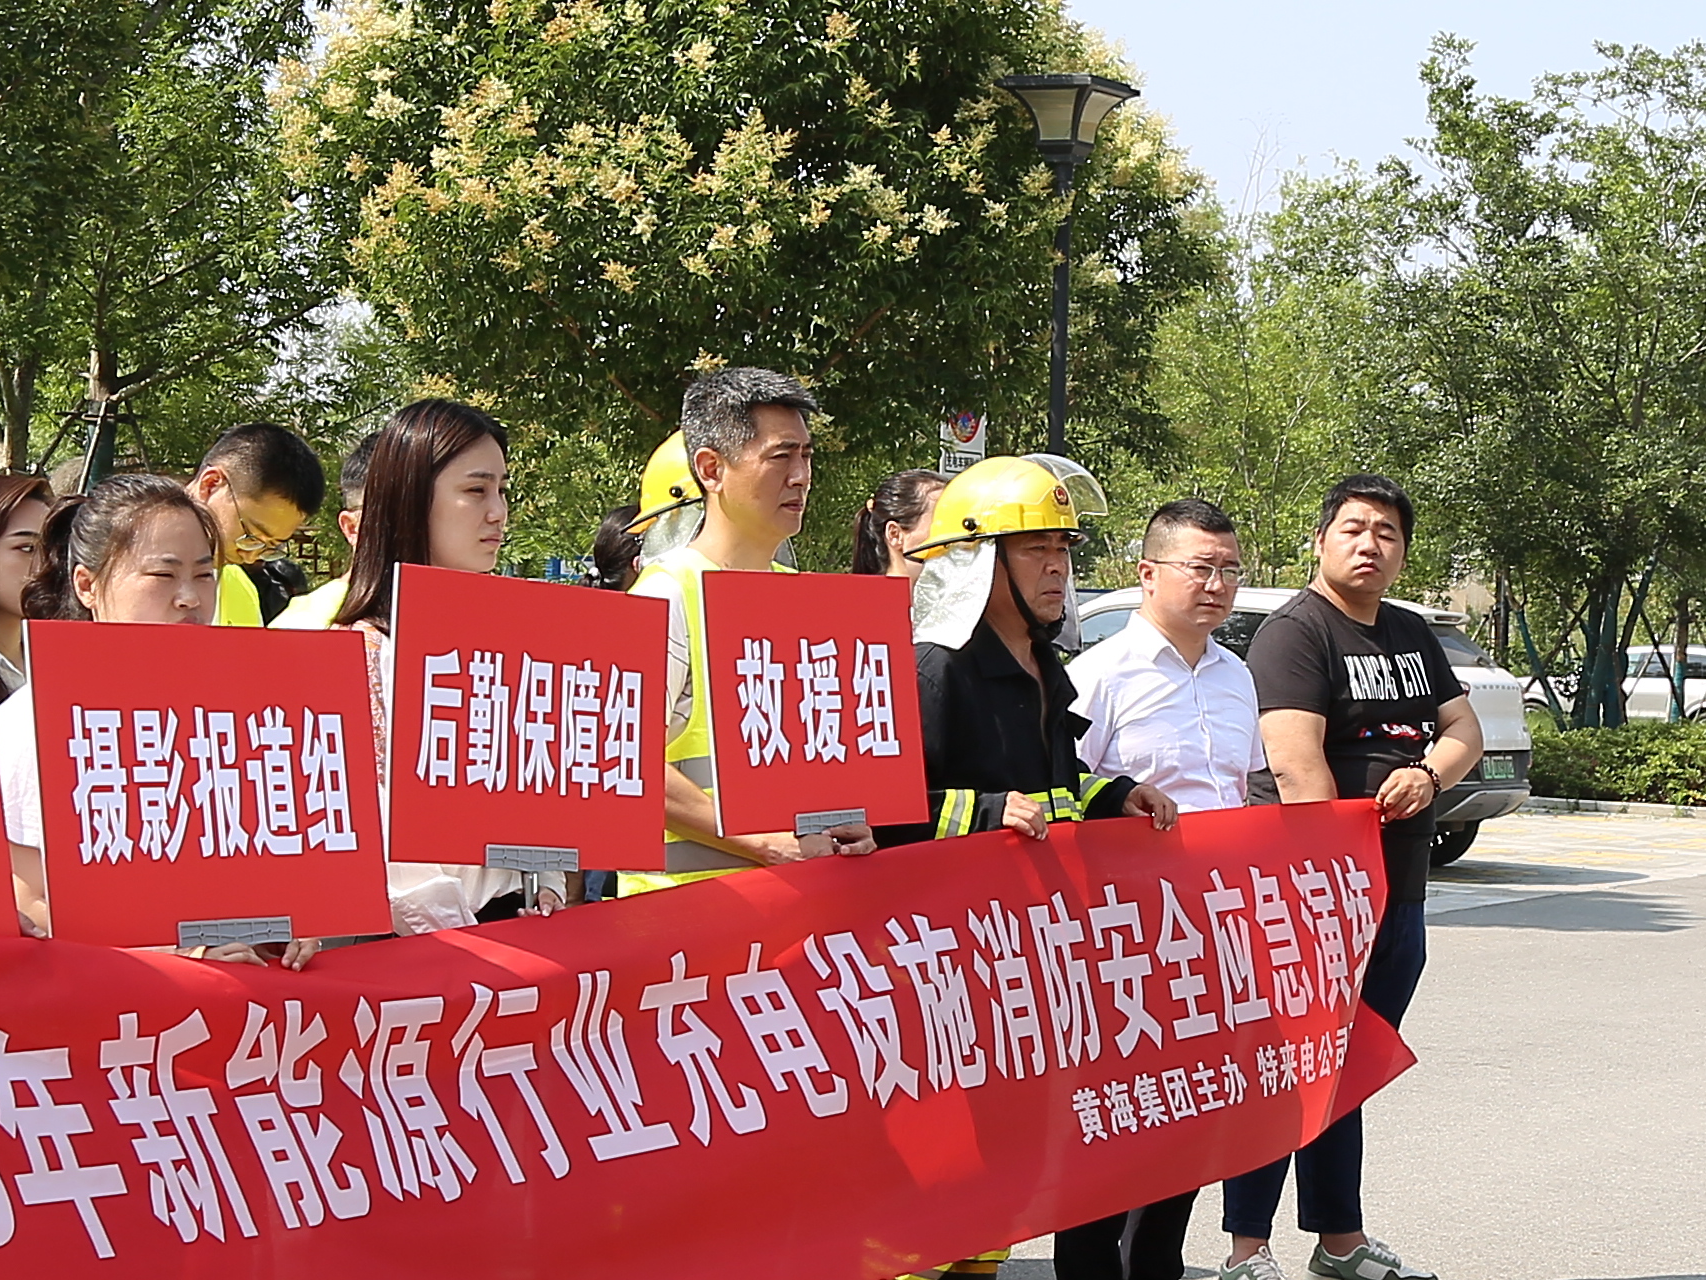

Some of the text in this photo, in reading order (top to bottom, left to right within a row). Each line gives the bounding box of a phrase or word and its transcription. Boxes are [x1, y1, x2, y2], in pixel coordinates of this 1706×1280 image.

[416, 648, 643, 798] 后勤保障组
[735, 637, 900, 767] 救援组
[1344, 652, 1431, 700] KANSAS CITY
[68, 705, 358, 865] 摄影报道组
[1072, 1022, 1354, 1144] 黄海集团主办 特来电公司
